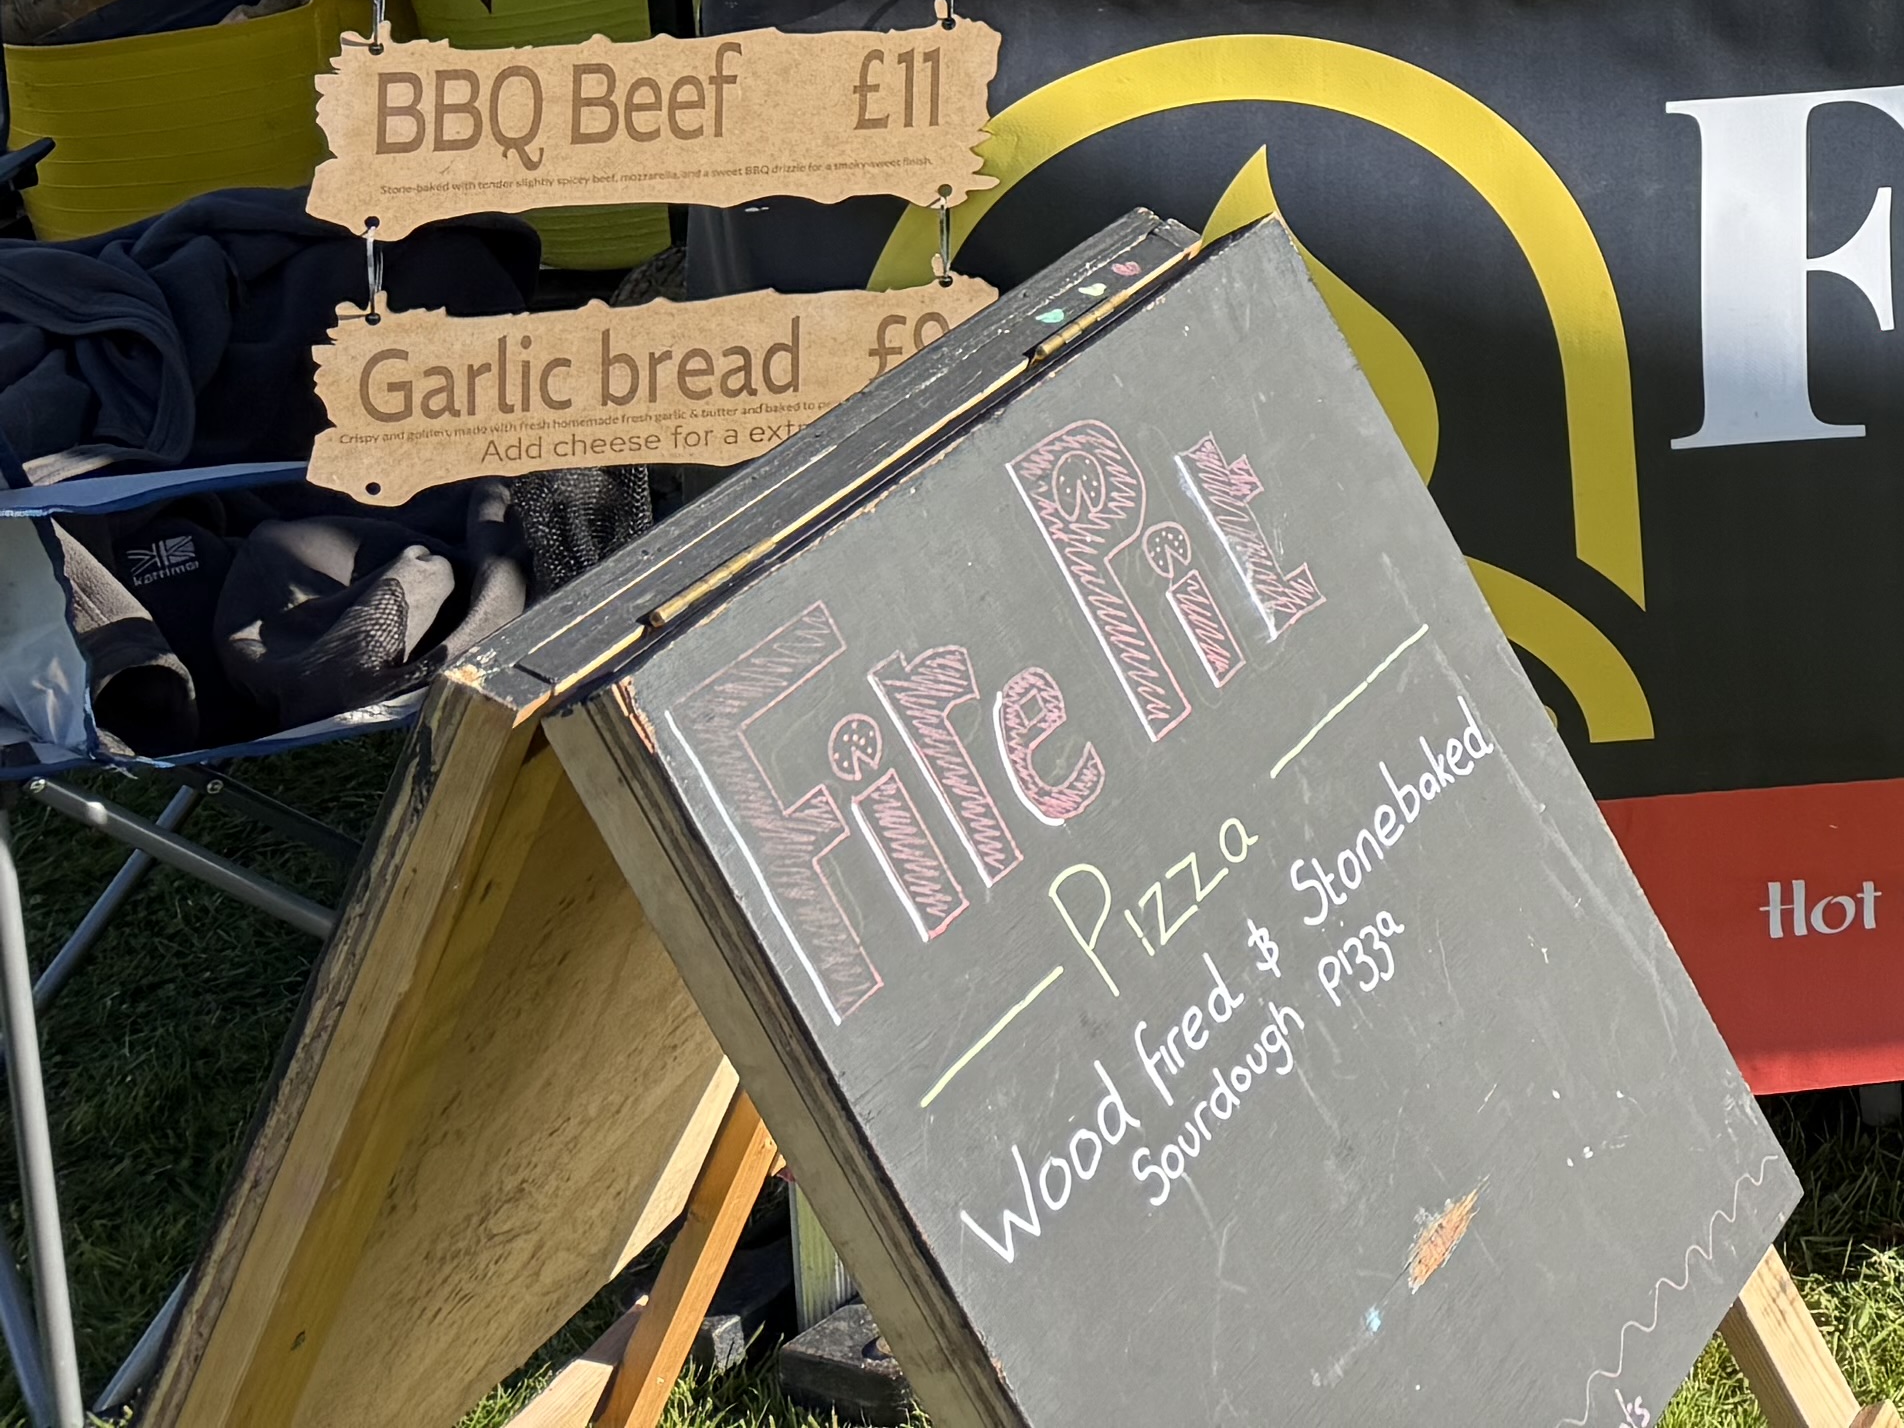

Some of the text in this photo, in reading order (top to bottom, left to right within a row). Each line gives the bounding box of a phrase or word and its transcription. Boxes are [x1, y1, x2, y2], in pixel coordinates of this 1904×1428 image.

[375, 42, 941, 170] BBQ Beef £11
[340, 432, 379, 446] Crispy
[520, 419, 550, 432] fresh
[552, 416, 618, 430] homemade
[654, 409, 686, 423] garlic
[765, 401, 800, 414] baked
[358, 334, 571, 425] Garlic
[600, 315, 800, 408] bread
[481, 436, 542, 464] Add
[554, 434, 661, 458] cheese
[671, 425, 713, 450] for
[724, 428, 738, 444] a
[664, 418, 1327, 1025] Fire Pit
[1049, 815, 1259, 997] Pizza
[1758, 877, 1883, 940] Hot
[960, 1060, 1140, 1264] Wood
[1134, 953, 1244, 1107] fired
[1290, 697, 1494, 927] Stonebaked
[1132, 909, 1406, 1207] Sourdough pizza
